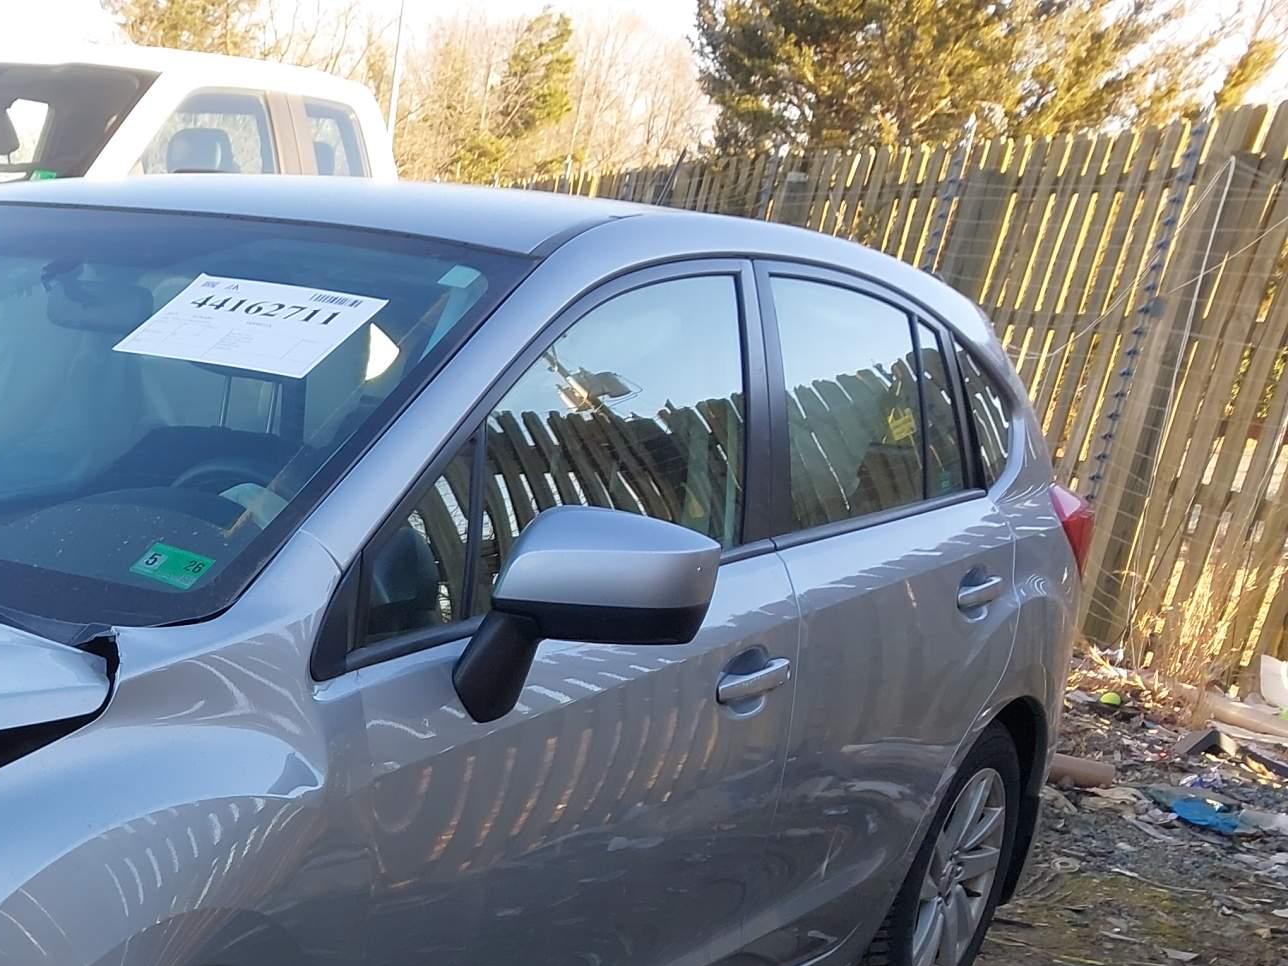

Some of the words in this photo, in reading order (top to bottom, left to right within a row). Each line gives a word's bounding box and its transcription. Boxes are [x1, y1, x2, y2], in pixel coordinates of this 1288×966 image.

[191, 295, 341, 326] 44162711
[145, 553, 162, 566] 5
[183, 560, 205, 574] 26
